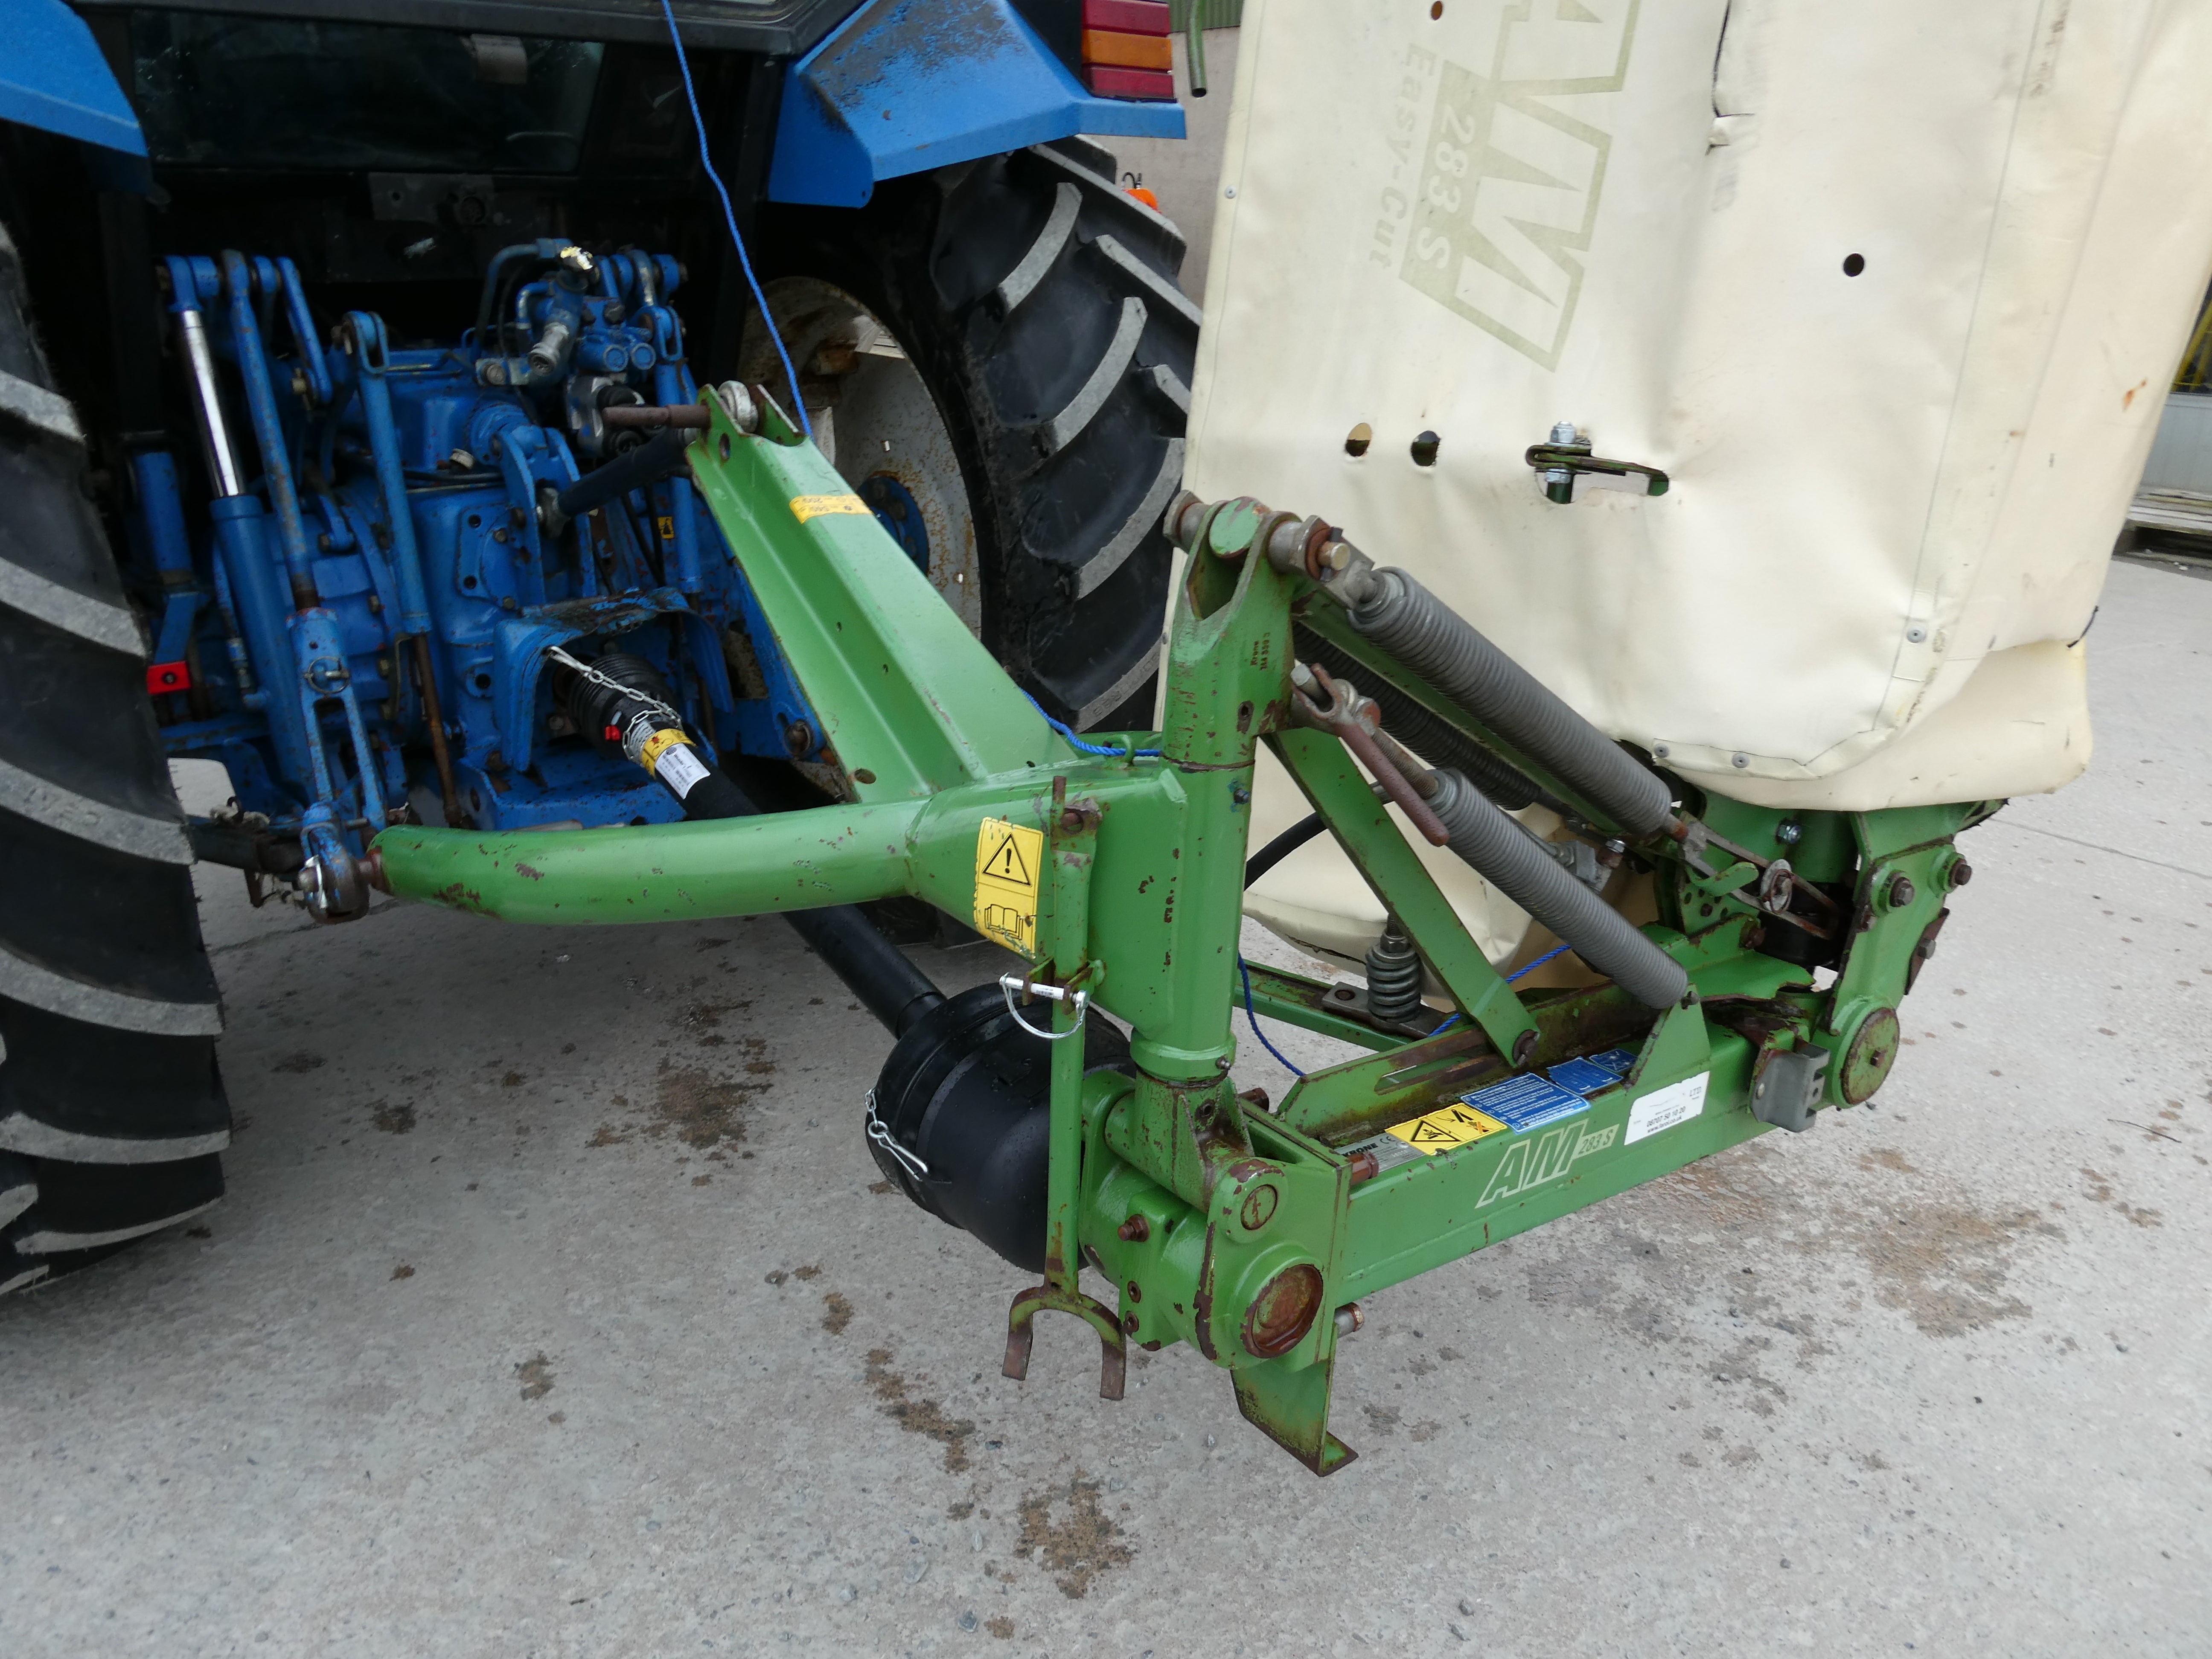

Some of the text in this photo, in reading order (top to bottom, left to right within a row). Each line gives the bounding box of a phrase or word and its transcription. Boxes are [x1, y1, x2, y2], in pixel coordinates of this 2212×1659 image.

[1369, 44, 1437, 270] Easy-Cut
[1416, 103, 1475, 270] 283 S
[1342, 1143, 1378, 1157] KRONE
[1475, 1118, 1589, 1208] AM
[1579, 1129, 1613, 1154] 283 S
